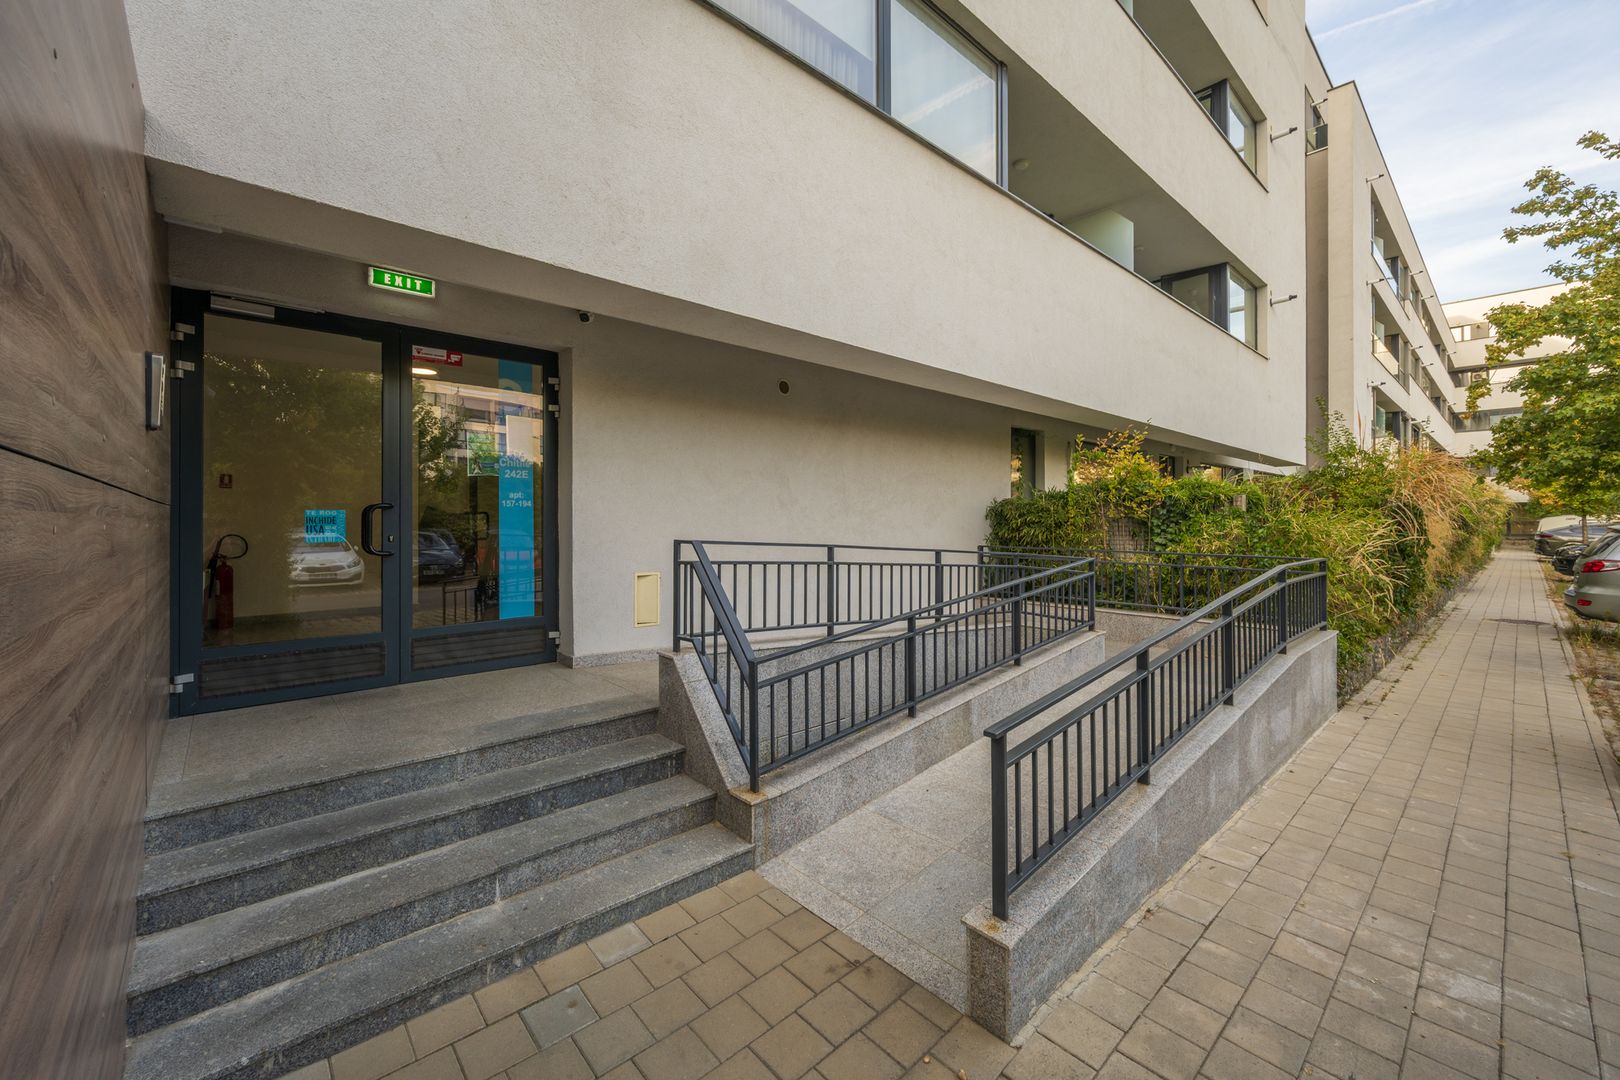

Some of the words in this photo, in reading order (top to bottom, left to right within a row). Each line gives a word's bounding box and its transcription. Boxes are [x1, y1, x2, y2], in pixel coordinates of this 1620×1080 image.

[384, 273, 422, 291] EXIT
[504, 469, 529, 479] 242E
[501, 500, 532, 508] 157-194
